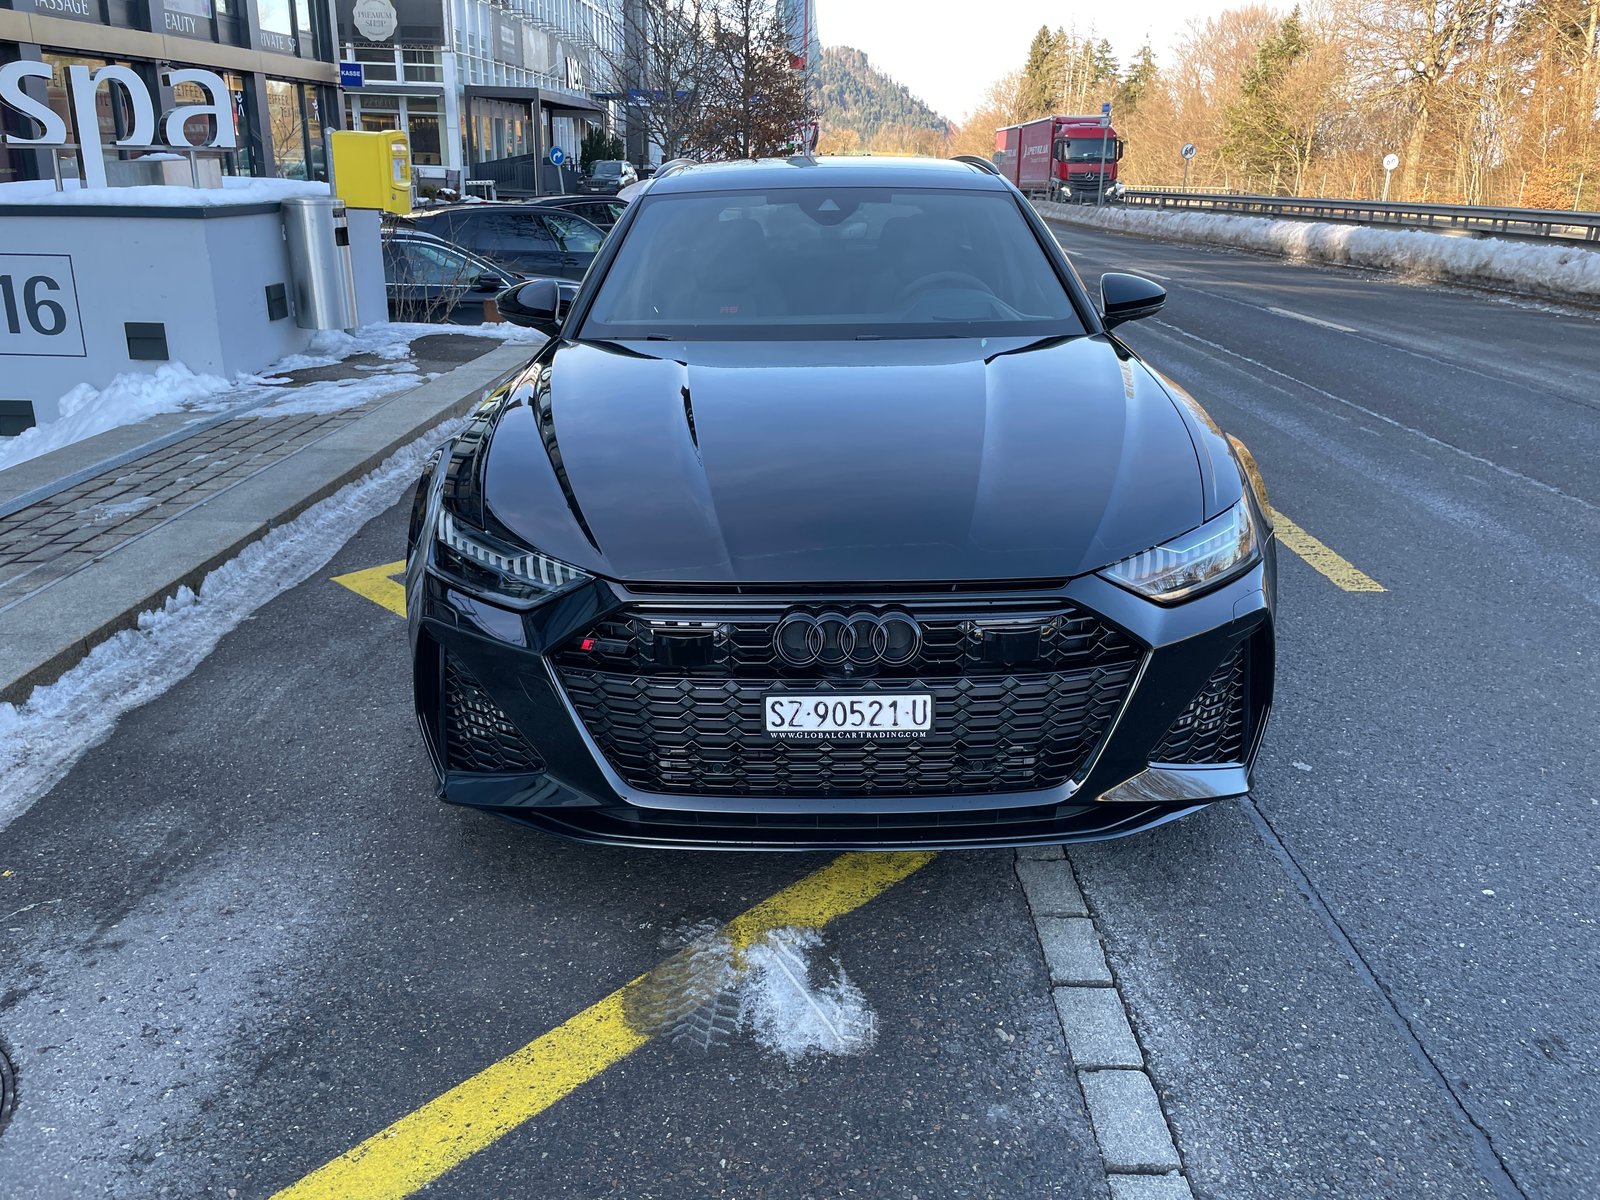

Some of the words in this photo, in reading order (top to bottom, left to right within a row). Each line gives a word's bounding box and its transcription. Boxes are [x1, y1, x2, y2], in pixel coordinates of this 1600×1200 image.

[35, 0, 90, 15] ASSAGE
[358, 10, 392, 19] PREMIUM
[0, 60, 237, 189] spa
[0, 274, 67, 336] 16
